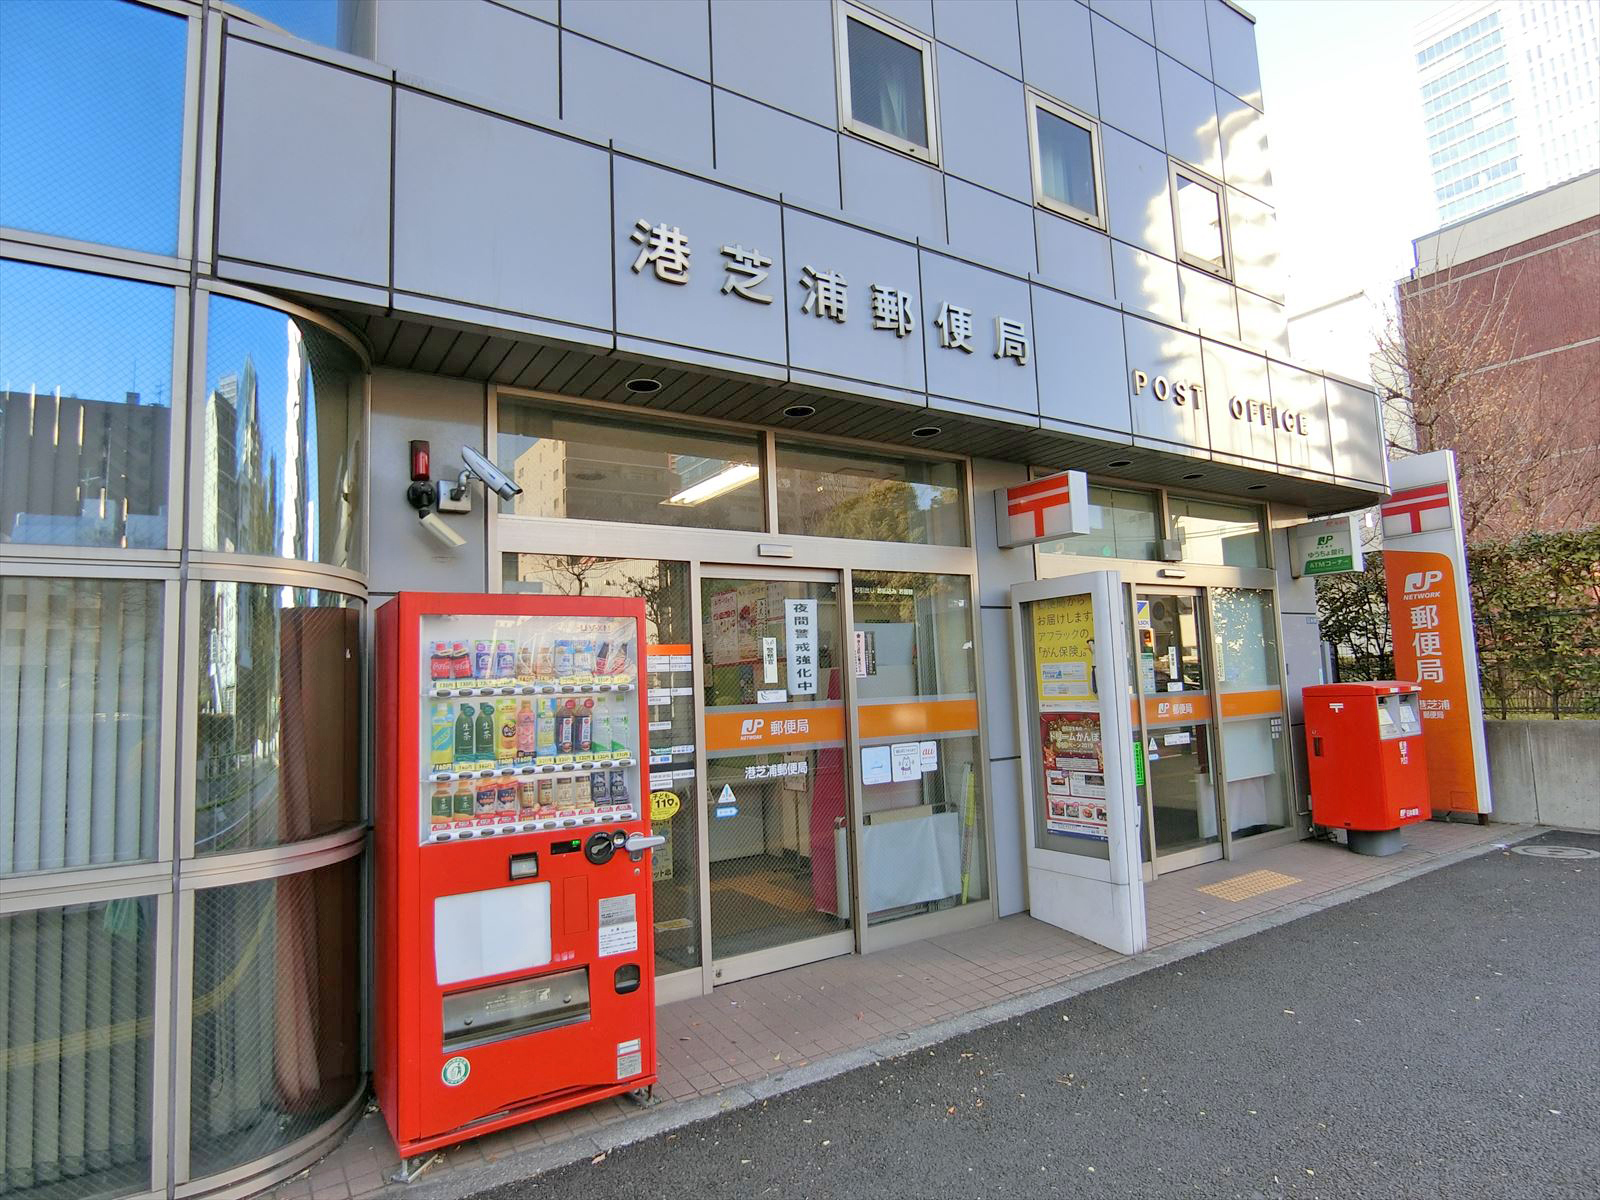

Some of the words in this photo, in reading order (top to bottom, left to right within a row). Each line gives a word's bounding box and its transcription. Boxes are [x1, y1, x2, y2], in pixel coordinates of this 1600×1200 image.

[630, 218, 1030, 367] 港芝浦郵便局
[1132, 368, 1203, 410] POST
[1229, 395, 1309, 436] OFFICE
[1404, 570, 1443, 593] JP
[1403, 592, 1441, 601] NETWORK
[793, 603, 813, 692] 夜間警戒強化中
[1410, 604, 1444, 684] 郵便局
[742, 718, 765, 735] JP
[770, 719, 809, 736] 郵便局
[745, 761, 808, 779] 港芝浦郵便局
